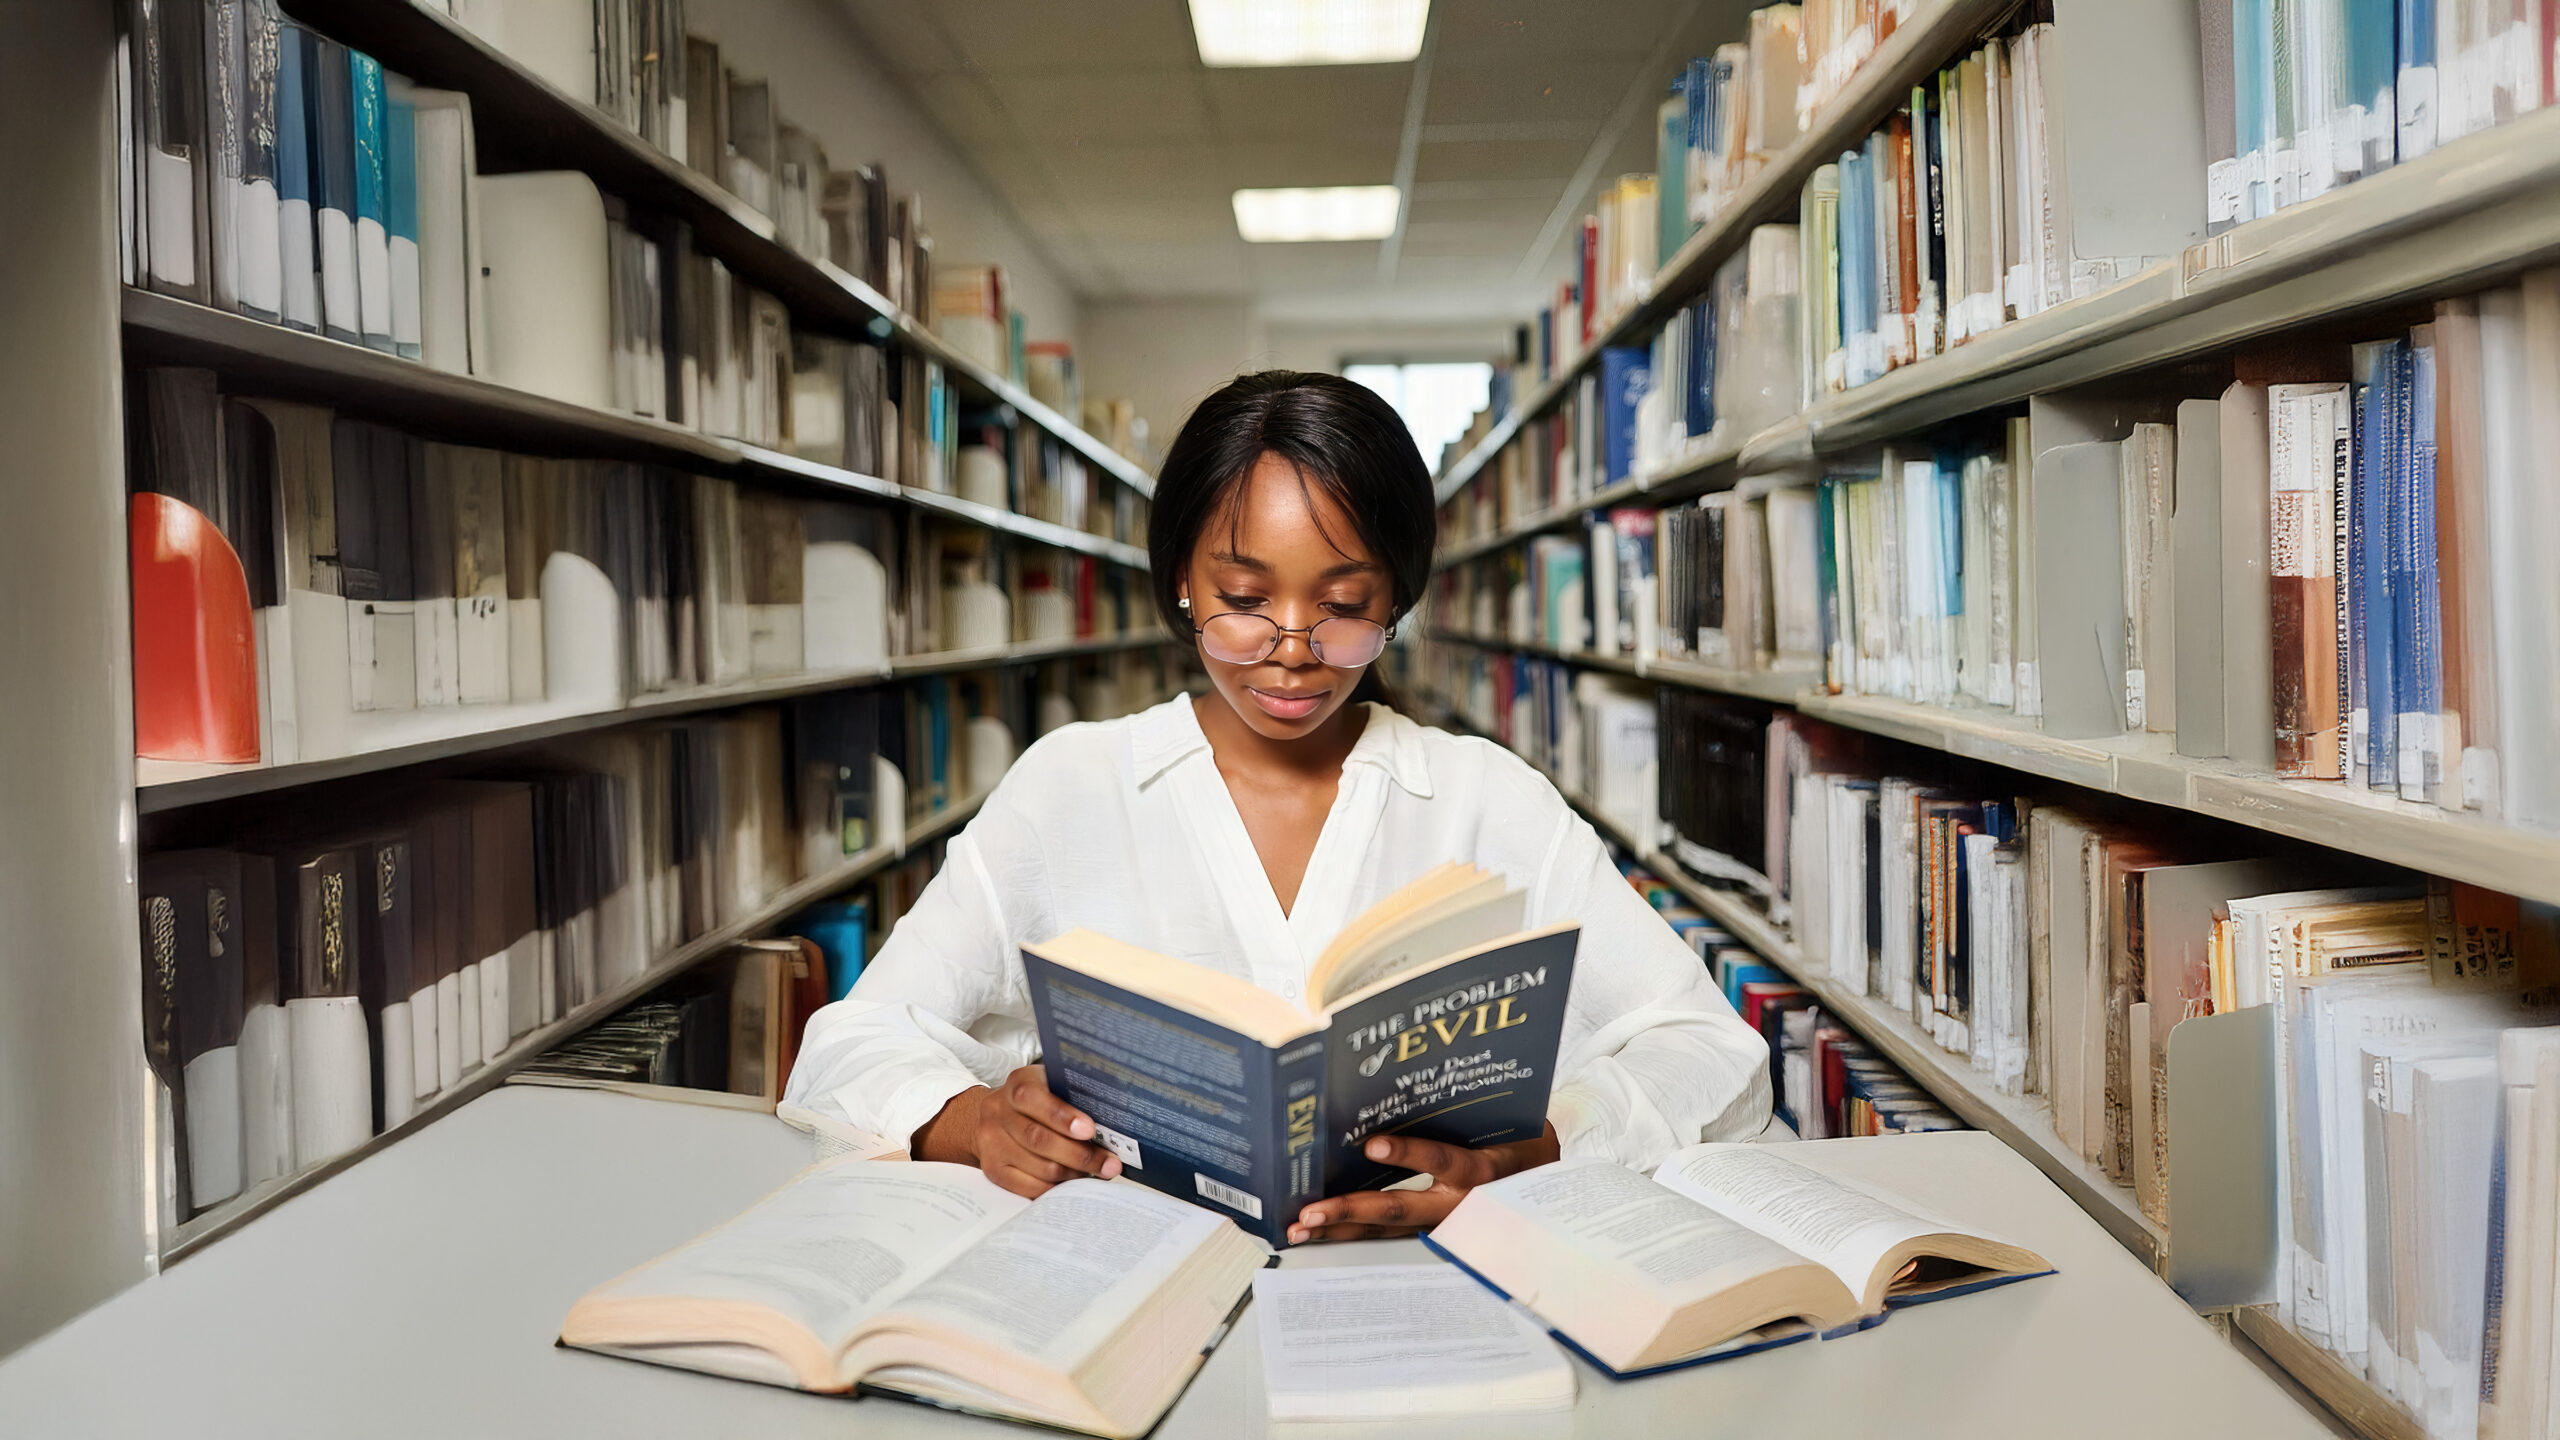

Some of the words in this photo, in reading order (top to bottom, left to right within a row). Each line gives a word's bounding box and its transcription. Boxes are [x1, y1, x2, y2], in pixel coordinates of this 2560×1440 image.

[1346, 1012, 1406, 1052] THE
[1413, 965, 1548, 1024] PROBLEM
[1395, 996, 1528, 1063] EVIL
[1287, 1094, 1316, 1156] EVIL
